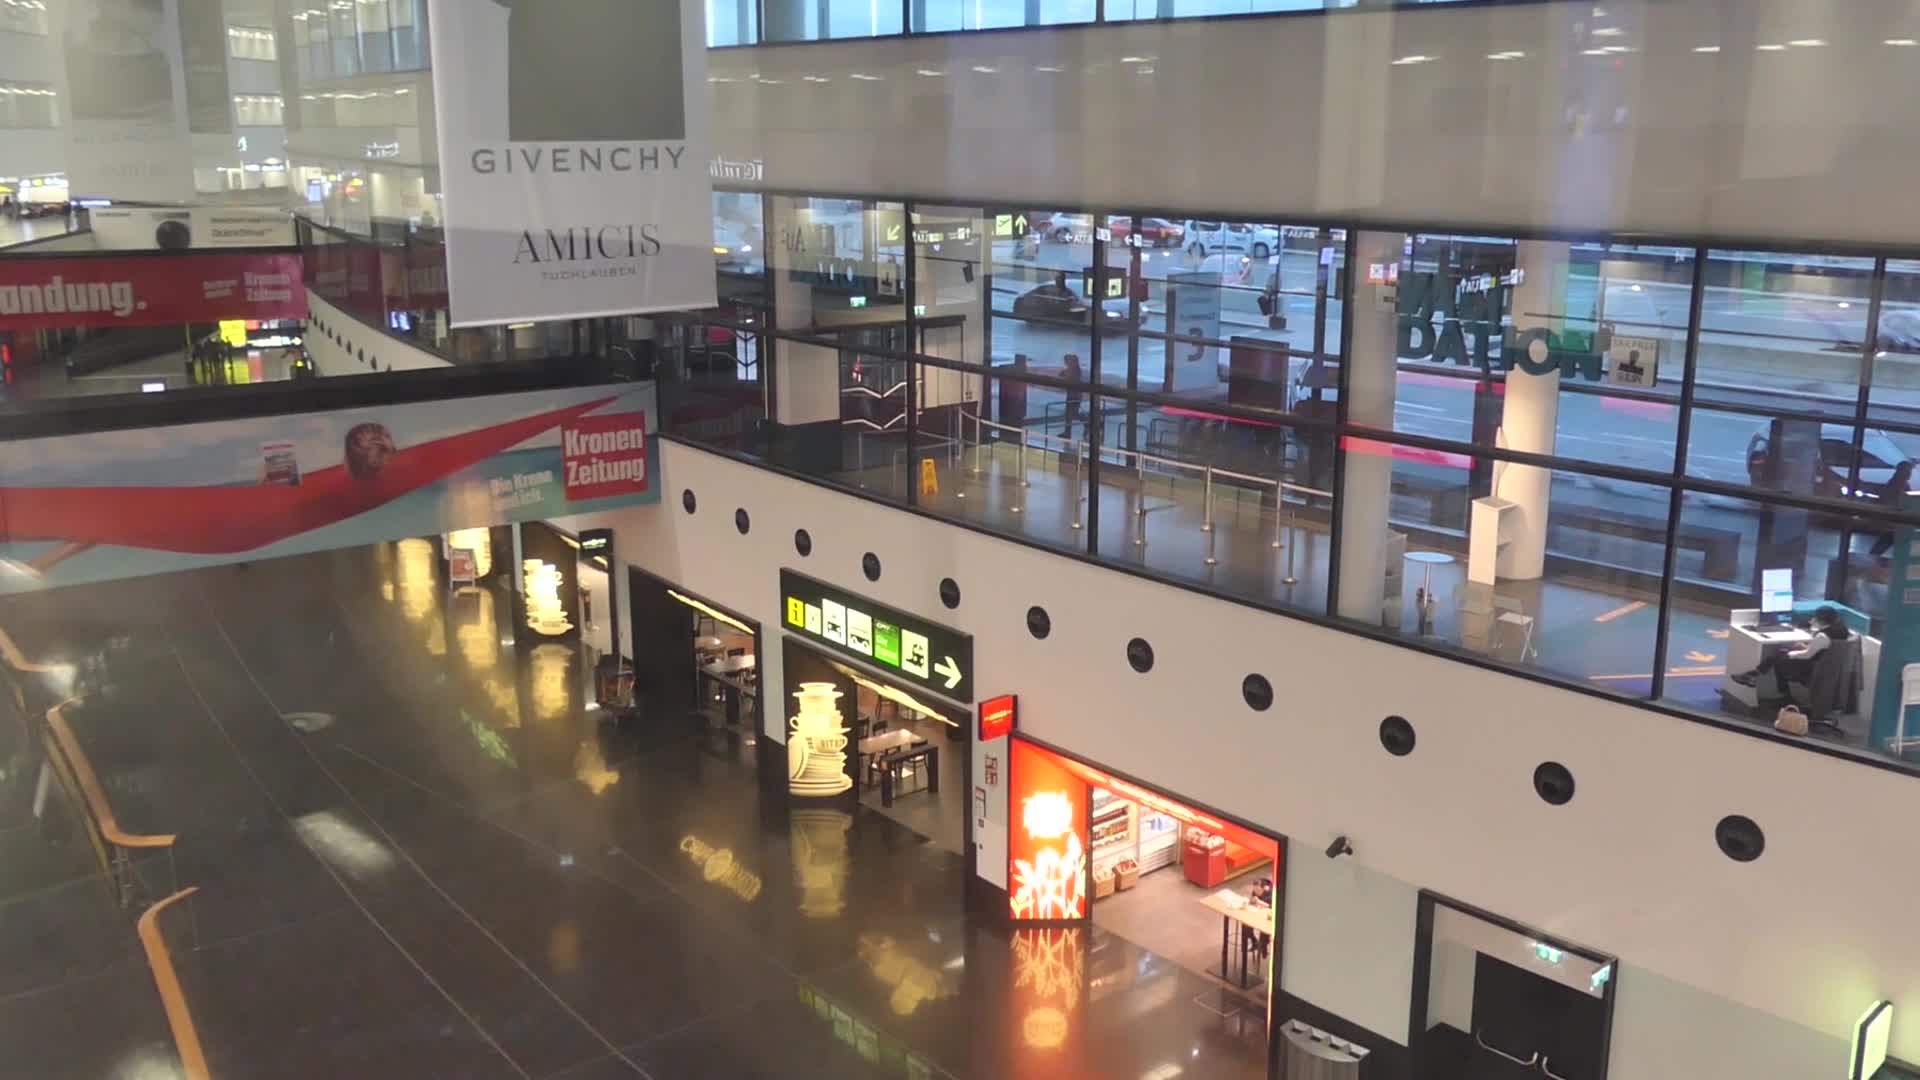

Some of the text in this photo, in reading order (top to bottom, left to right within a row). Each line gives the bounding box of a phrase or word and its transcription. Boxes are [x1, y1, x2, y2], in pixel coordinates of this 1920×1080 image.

[471, 146, 685, 175] GIVENCHY
[512, 224, 662, 264] AMICIS
[565, 428, 644, 457] Kronen
[567, 457, 645, 487] Zeitung
